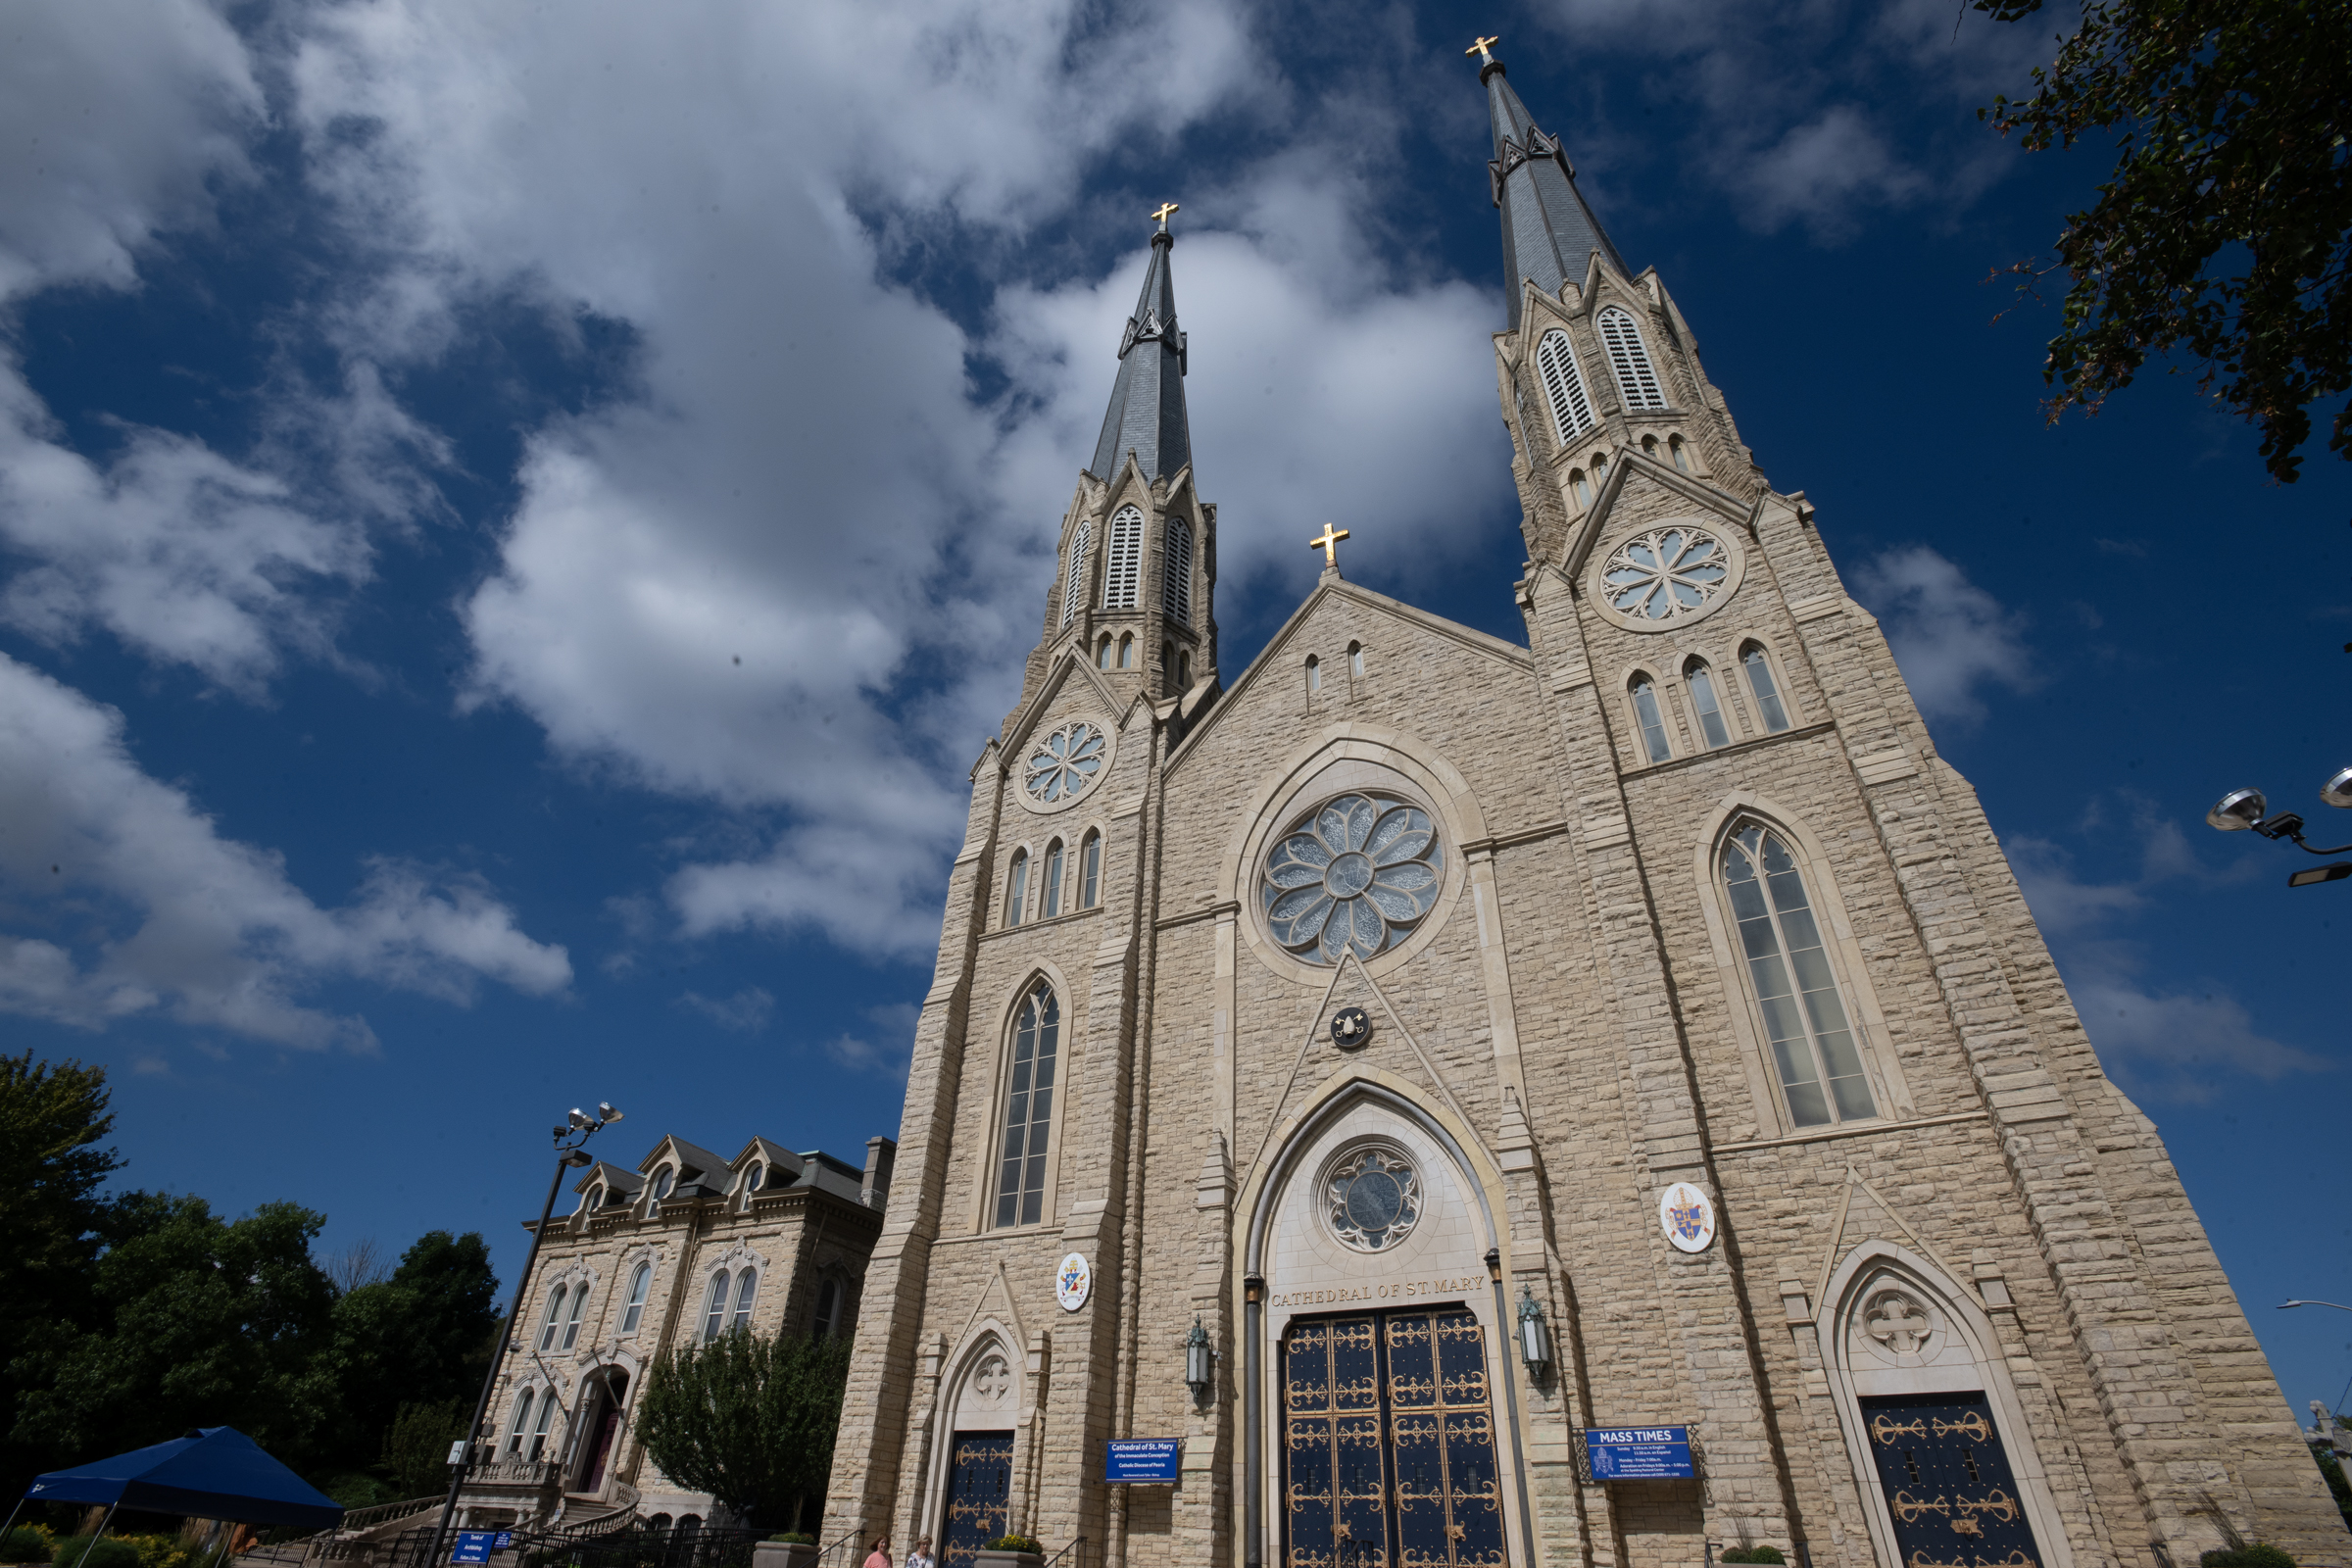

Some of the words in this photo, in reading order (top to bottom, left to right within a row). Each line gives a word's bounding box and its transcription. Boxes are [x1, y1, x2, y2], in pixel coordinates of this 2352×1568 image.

[1271, 1286, 1372, 1306] CATHEDRAL
[1378, 1283, 1400, 1298] OF
[1599, 1432, 1634, 1443] MASS
[1634, 1430, 1672, 1442] TIMES
[1158, 1443, 1174, 1452] Mary
